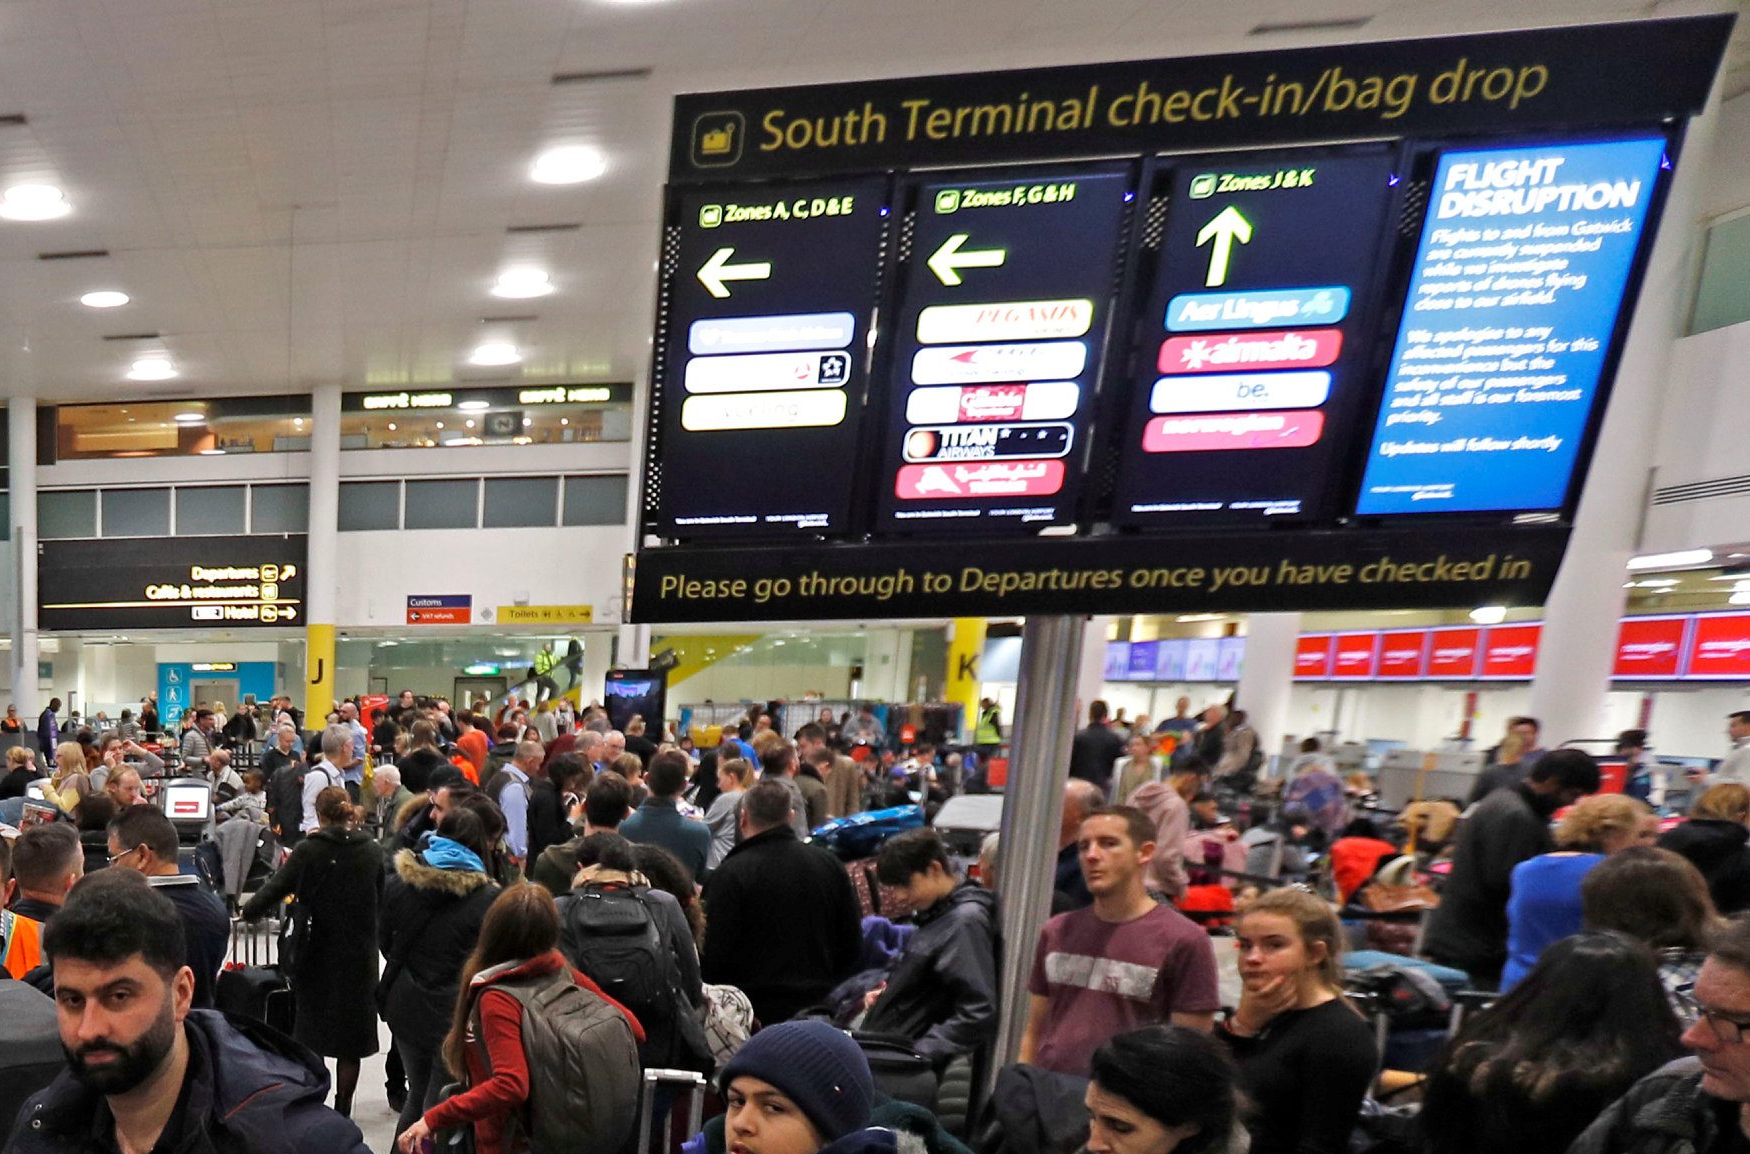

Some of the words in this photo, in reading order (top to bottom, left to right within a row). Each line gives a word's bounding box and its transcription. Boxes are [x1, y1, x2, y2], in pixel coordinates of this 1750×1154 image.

[759, 101, 887, 151] South
[902, 85, 1099, 141] Terminal
[1107, 66, 1419, 127] check-in/bag
[1428, 58, 1549, 110] drop
[1216, 173, 1271, 193] Zones
[1270, 170, 1282, 189] J
[1282, 169, 1300, 188] &
[1298, 168, 1316, 187] K
[1444, 157, 1566, 191] FLIGHT
[724, 204, 773, 222] Zones
[772, 200, 791, 221] A,
[792, 199, 809, 220] C,
[810, 198, 826, 217] D
[825, 196, 840, 216] &
[840, 196, 854, 214] E
[961, 189, 1013, 209] Zones
[1011, 186, 1027, 207] F,
[1027, 185, 1043, 204] G
[1043, 184, 1059, 203] &
[1058, 183, 1077, 202] H
[1437, 180, 1641, 219] DISRUPTION
[1430, 228, 1482, 247] Flights
[1482, 227, 1500, 242] to
[1500, 223, 1533, 240] and
[1532, 221, 1569, 238] from
[1570, 217, 1634, 236] Gatwick
[1177, 300, 1222, 323] Aer
[1221, 297, 1300, 325] Lingus
[938, 428, 1000, 447] TITAN
[937, 445, 996, 458] AIRWAYS
[191, 565, 260, 583] Departures
[659, 574, 748, 600] Please
[754, 576, 792, 603] go
[798, 568, 915, 602] through
[923, 570, 952, 593] to
[959, 566, 1122, 598] Departures
[1129, 565, 1205, 589] once
[1207, 564, 1271, 593] you
[1275, 559, 1352, 585] have
[1357, 553, 1496, 584] checked
[1497, 554, 1533, 580] in
[224, 605, 259, 620] Hotel
[410, 599, 443, 607] Customs
[509, 610, 539, 618] Toilets
[311, 658, 324, 685] J
[958, 653, 980, 681] K
